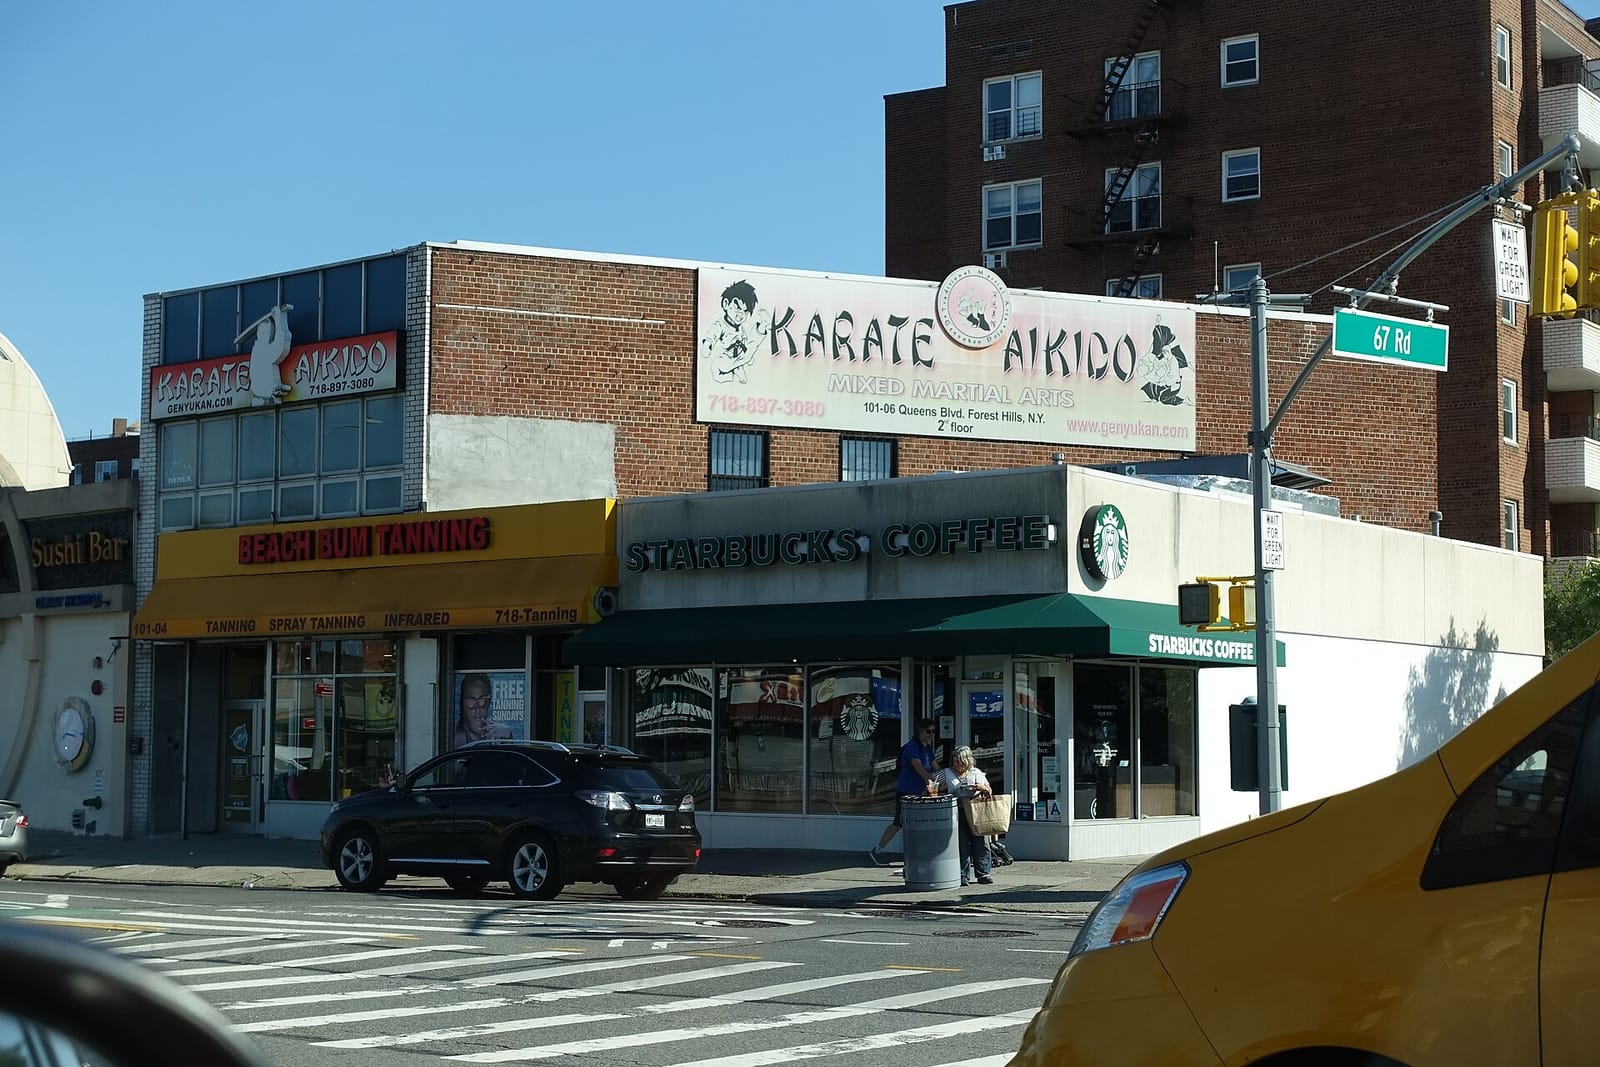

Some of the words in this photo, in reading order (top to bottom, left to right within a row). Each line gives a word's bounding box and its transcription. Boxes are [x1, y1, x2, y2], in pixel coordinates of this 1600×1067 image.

[1501, 228, 1520, 244] WAIT
[1503, 245, 1519, 260] FOR
[1499, 261, 1525, 278] GREEN
[1501, 279, 1524, 296] LIGHT
[770, 306, 937, 370] KARATE
[1003, 327, 1139, 383] AIKIDO
[1373, 325, 1390, 351] 67
[1395, 331, 1411, 355] Rd
[156, 361, 250, 404] KARATE
[294, 340, 388, 384] AIKIDO
[309, 377, 374, 395] 718-897-3080
[827, 373, 906, 395] MIXED
[911, 379, 1013, 404] MARTIAL
[1018, 386, 1075, 408] ARTS
[167, 397, 233, 414] GENYUKAN.COM
[708, 394, 826, 418] 718-897-3080
[863, 402, 896, 414] 101-06
[898, 404, 937, 417] Queens
[941, 407, 965, 419] Blvd.
[968, 409, 999, 421] Forest
[1001, 411, 1025, 424] Hills,
[1028, 413, 1046, 424] N.Y.
[951, 422, 974, 433] floor
[1066, 418, 1189, 439] www.genyukan.com
[1266, 514, 1279, 525] WAIT
[238, 530, 314, 564] BEACH
[318, 526, 372, 560] BUM
[375, 516, 491, 555] TANNING
[1267, 527, 1279, 538] FOR
[31, 534, 82, 568] Sushi
[89, 530, 126, 562] Bar
[626, 527, 860, 574] STARBUCKS
[880, 513, 1050, 560] COFFEE
[1264, 540, 1283, 552] GREEN
[1265, 553, 1282, 566] LIGHT
[206, 618, 256, 633] TANNING
[269, 617, 307, 632] SPRAY
[310, 614, 366, 630] TANNING
[384, 611, 450, 628] INFRARED
[494, 606, 578, 626] 718-Tanning
[133, 621, 167, 636] 101-04
[1149, 633, 1213, 658] STARBUCKS
[1214, 640, 1254, 660] COFFEE
[493, 680, 524, 698] FREE
[492, 700, 524, 711] TANNING
[492, 710, 524, 721] SUNDAYS
